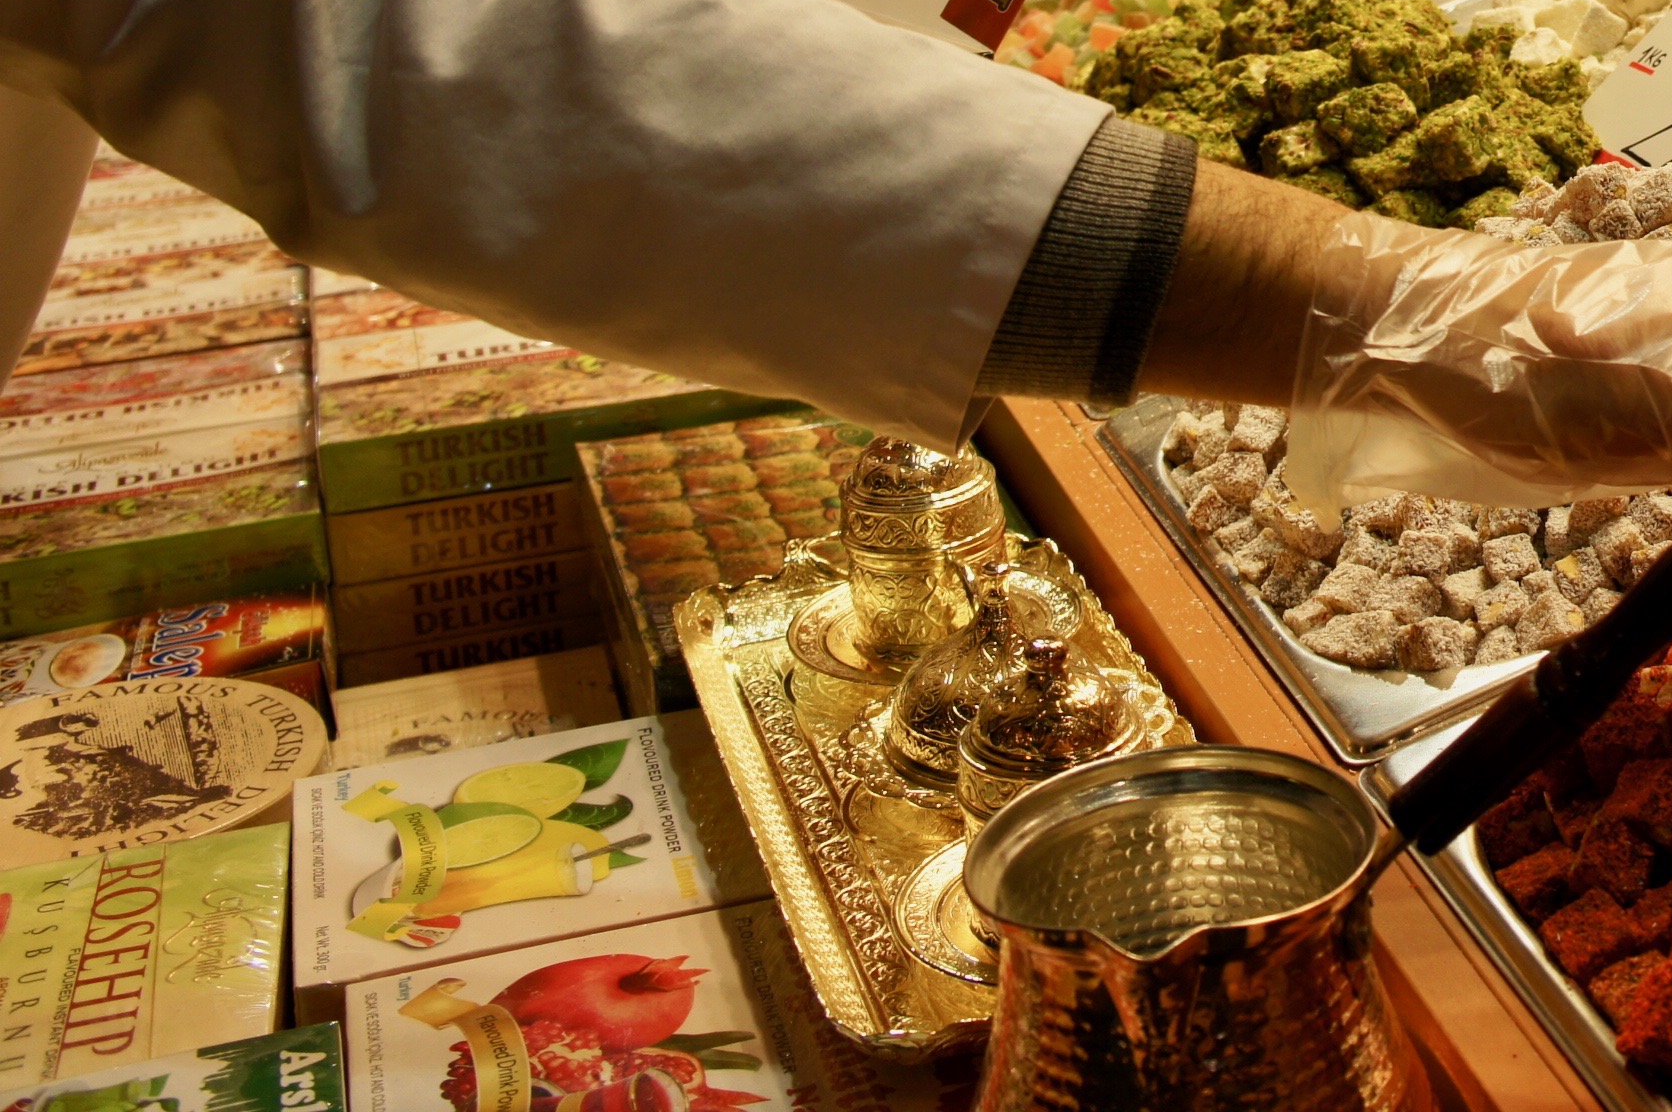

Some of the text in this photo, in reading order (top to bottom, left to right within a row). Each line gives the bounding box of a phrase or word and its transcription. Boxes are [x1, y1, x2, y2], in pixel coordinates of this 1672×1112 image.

[1638, 45, 1667, 69] 1KG
[398, 422, 546, 467] TURKISH
[117, 448, 281, 487] DELIGHT
[400, 451, 549, 497] DELIGHT
[405, 492, 556, 537] TURKISH
[410, 521, 559, 567] DELIGHT
[409, 561, 559, 606] TURKISH
[414, 590, 560, 636] DELIGHT
[127, 602, 229, 681] Salep
[415, 628, 564, 673] TURKISH
[49, 682, 238, 710] FAMOUS
[245, 693, 304, 774] TURKISH
[637, 727, 662, 785] FLOVOURED
[335, 773, 351, 801] Turkey
[652, 785, 670, 814] DRINK
[660, 815, 682, 854] POWDER
[420, 846, 437, 869] Drink
[412, 866, 437, 896] Powder
[57, 947, 82, 1003] FLAVOURED
[61, 859, 164, 1056] ROSEHIP
[398, 975, 413, 1002] Turkey
[49, 1004, 68, 1046] INSTANT
[756, 985, 778, 1021] DRINK
[771, 1022, 796, 1074] POWDER
[476, 1015, 512, 1059] Flavoured
[497, 1060, 521, 1090] Drink
